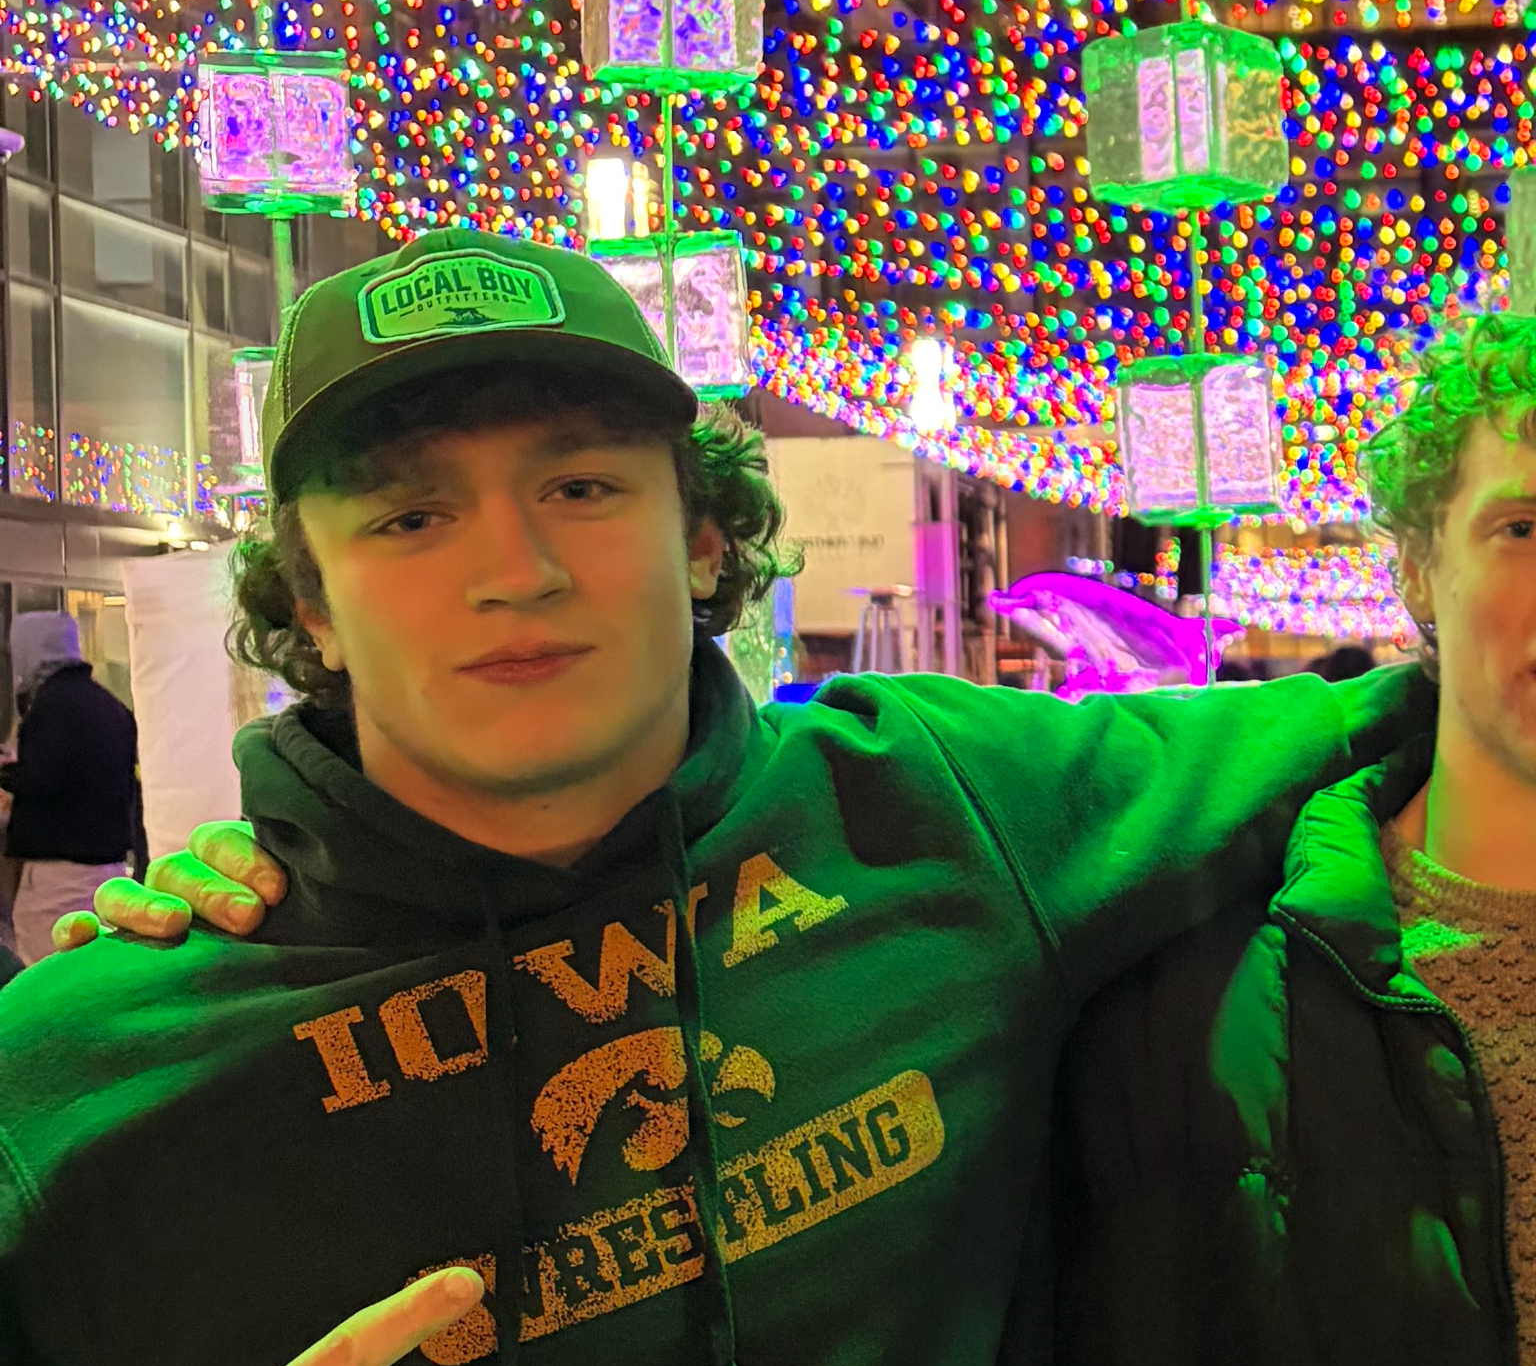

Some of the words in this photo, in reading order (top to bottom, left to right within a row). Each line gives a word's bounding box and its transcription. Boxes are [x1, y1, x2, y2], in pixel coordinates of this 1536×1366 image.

[381, 268, 472, 316] LOCAL
[476, 266, 533, 300] BOY
[417, 291, 509, 313] OUTFITTERS
[293, 852, 850, 1114] IOWA
